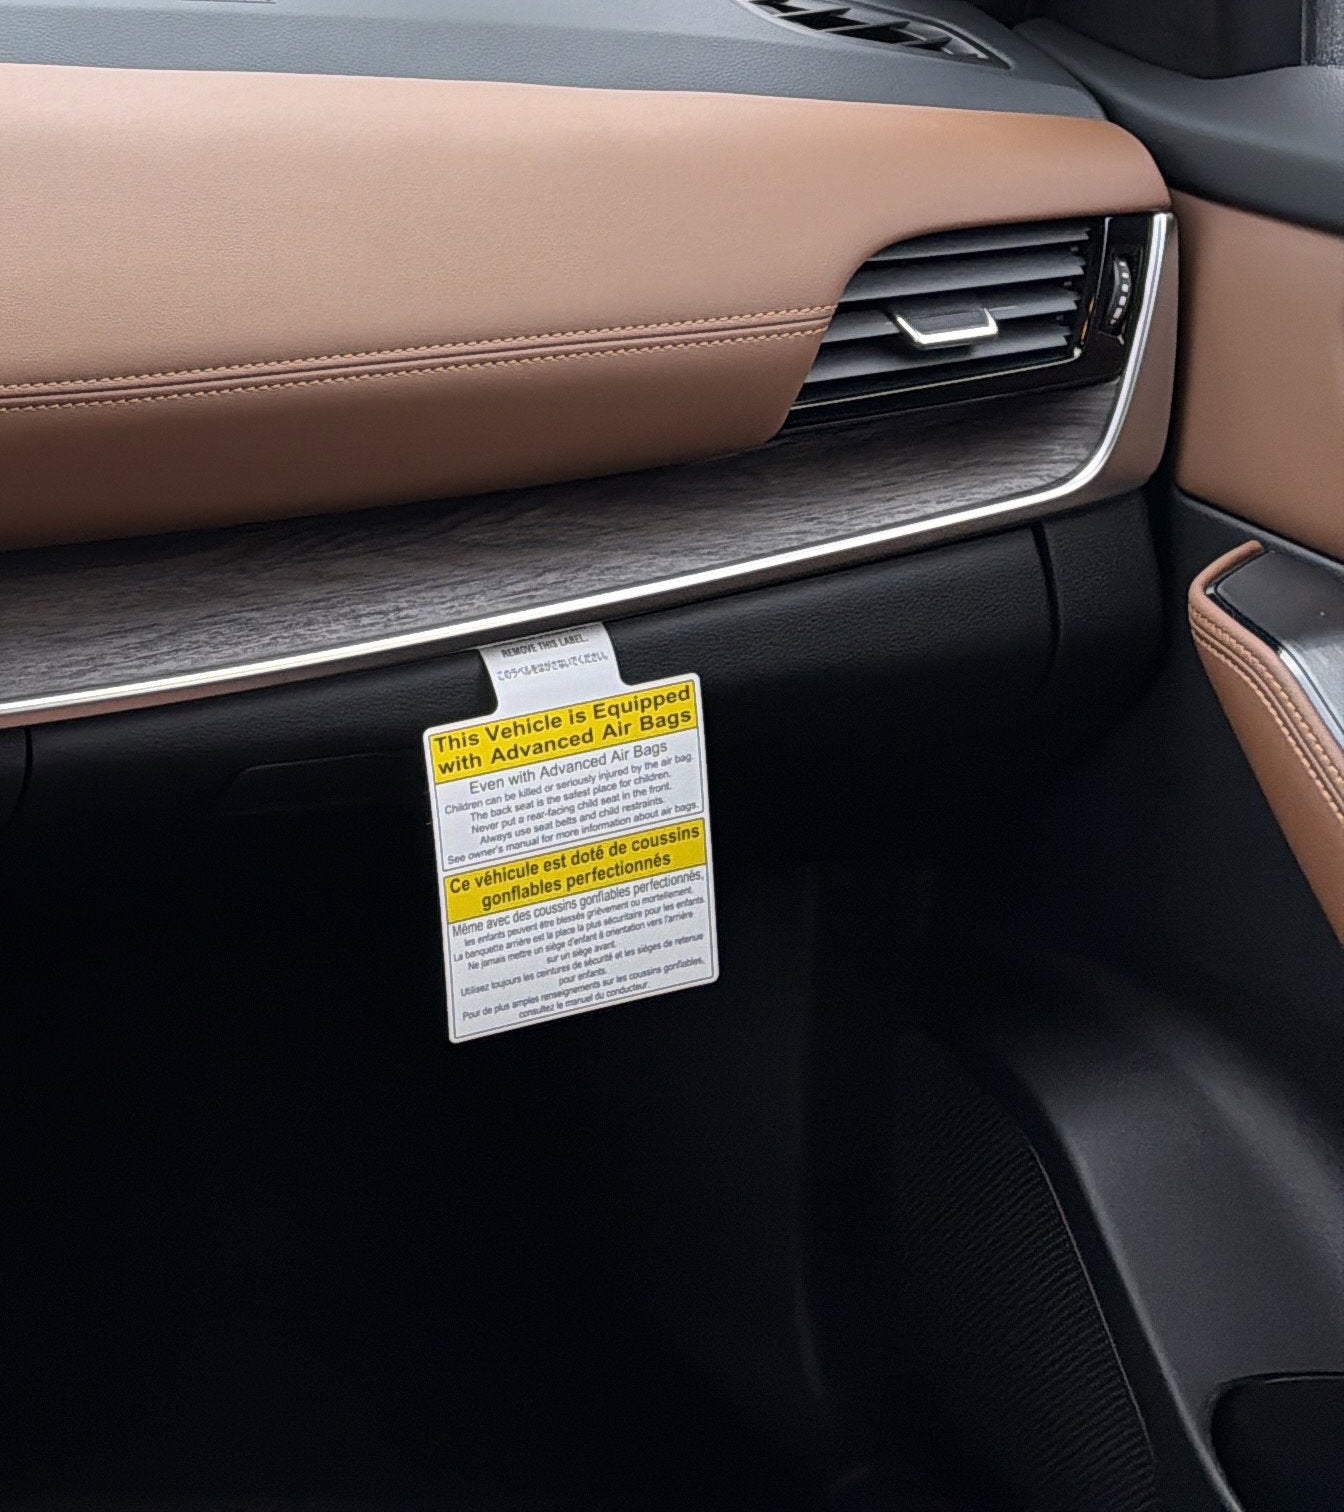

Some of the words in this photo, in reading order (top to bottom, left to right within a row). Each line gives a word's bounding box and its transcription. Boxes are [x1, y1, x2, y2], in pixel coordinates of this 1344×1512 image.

[433, 732, 479, 753] This
[485, 714, 562, 742] Vehicle
[568, 709, 587, 725] is
[593, 685, 690, 719] Equipped
[438, 753, 482, 775] with
[491, 727, 594, 764] Advanced
[602, 721, 632, 740] Air
[640, 710, 691, 731] Bags
[444, 798, 484, 815] Children
[484, 794, 503, 806] can
[504, 792, 517, 802] be
[518, 784, 543, 799] killed
[544, 783, 554, 793] or
[555, 774, 597, 792] seriously
[598, 765, 629, 782] injured
[630, 764, 642, 775] by
[644, 760, 659, 771] the
[660, 757, 673, 770] air
[674, 753, 695, 764] bag.
[469, 777, 505, 795] Even
[507, 769, 536, 788] with
[539, 752, 607, 780] Advanced
[610, 748, 630, 766] Air
[633, 742, 668, 760] Bags
[450, 878, 470, 894] Ce
[475, 861, 539, 888] véhicule
[543, 854, 567, 872] est
[571, 845, 604, 866] doté
[609, 841, 627, 857] de
[631, 826, 700, 852] coussins
[482, 879, 562, 911] gonflables
[566, 852, 671, 892] perfectionnés
[452, 921, 484, 938] Même
[486, 914, 515, 930] avec
[515, 910, 532, 924] des
[533, 898, 578, 919] coussins
[579, 886, 631, 910] gonflables
[632, 870, 705, 898] perfectionnés,
